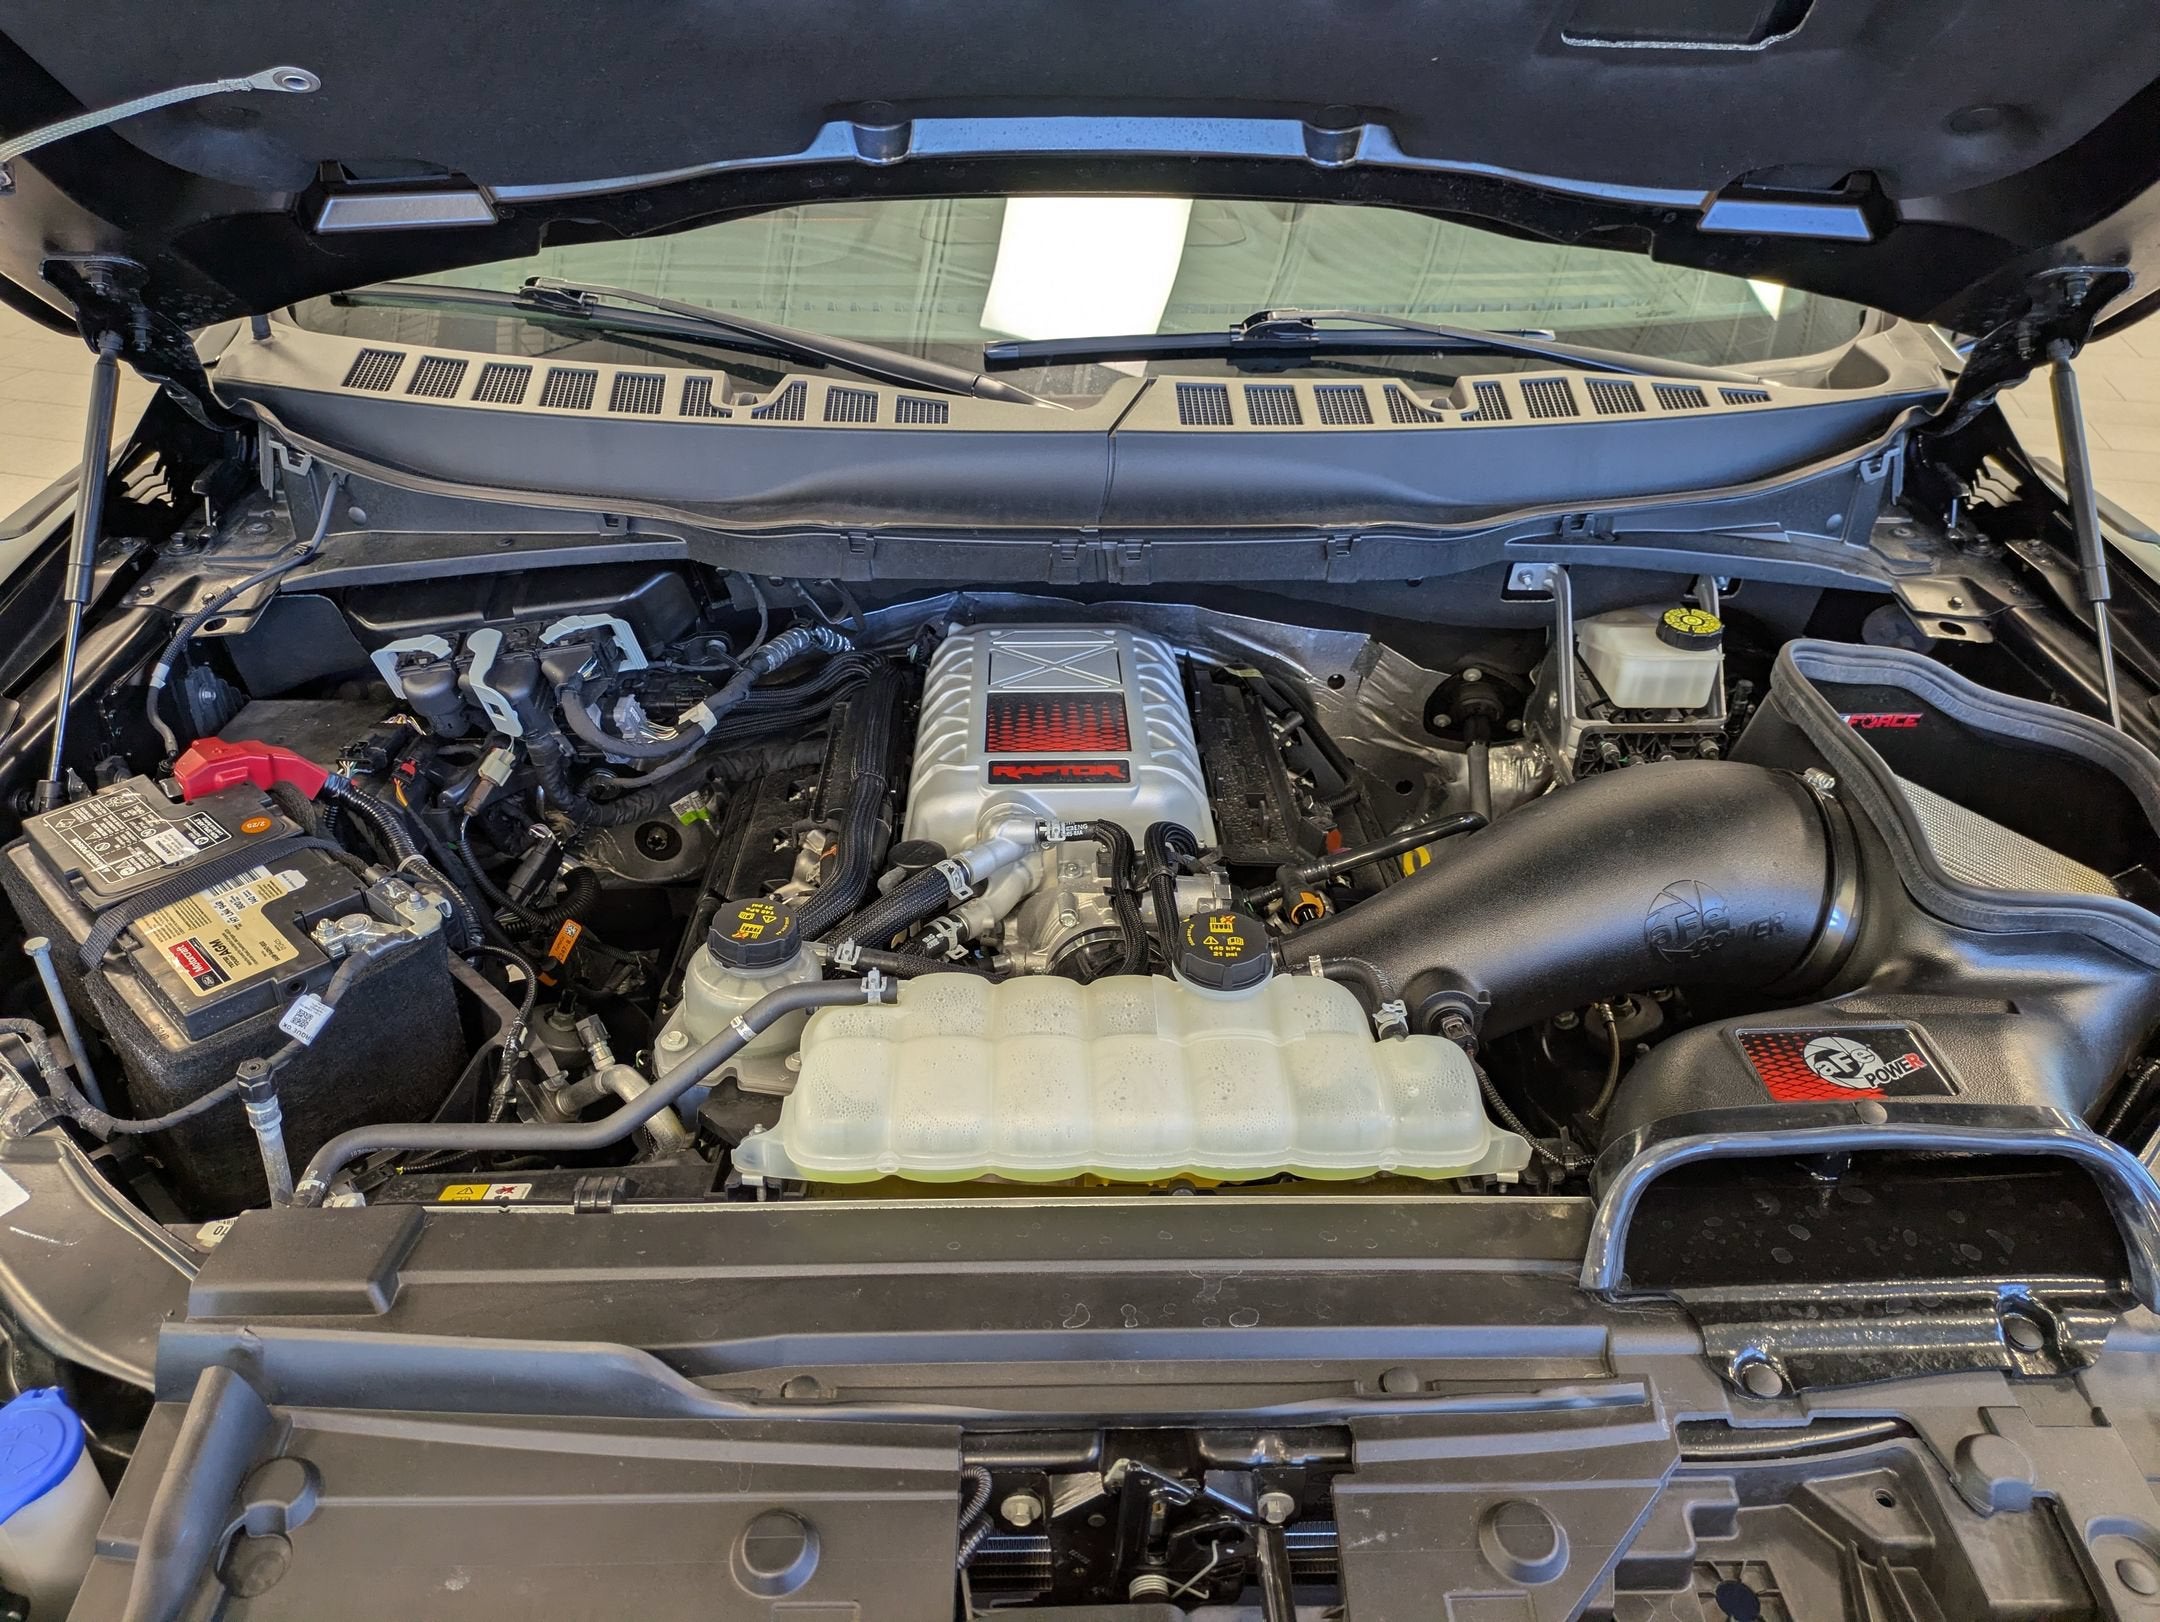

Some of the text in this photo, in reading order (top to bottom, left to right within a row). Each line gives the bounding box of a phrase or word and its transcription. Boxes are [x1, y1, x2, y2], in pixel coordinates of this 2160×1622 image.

[1848, 713, 1919, 728] FORCE
[993, 764, 1126, 780] RAPTOR
[176, 944, 204, 972] Motorcraft
[209, 938, 231, 956] AGM
[1814, 1048, 1875, 1077] aFe
[1863, 1052, 1927, 1090] POWER
